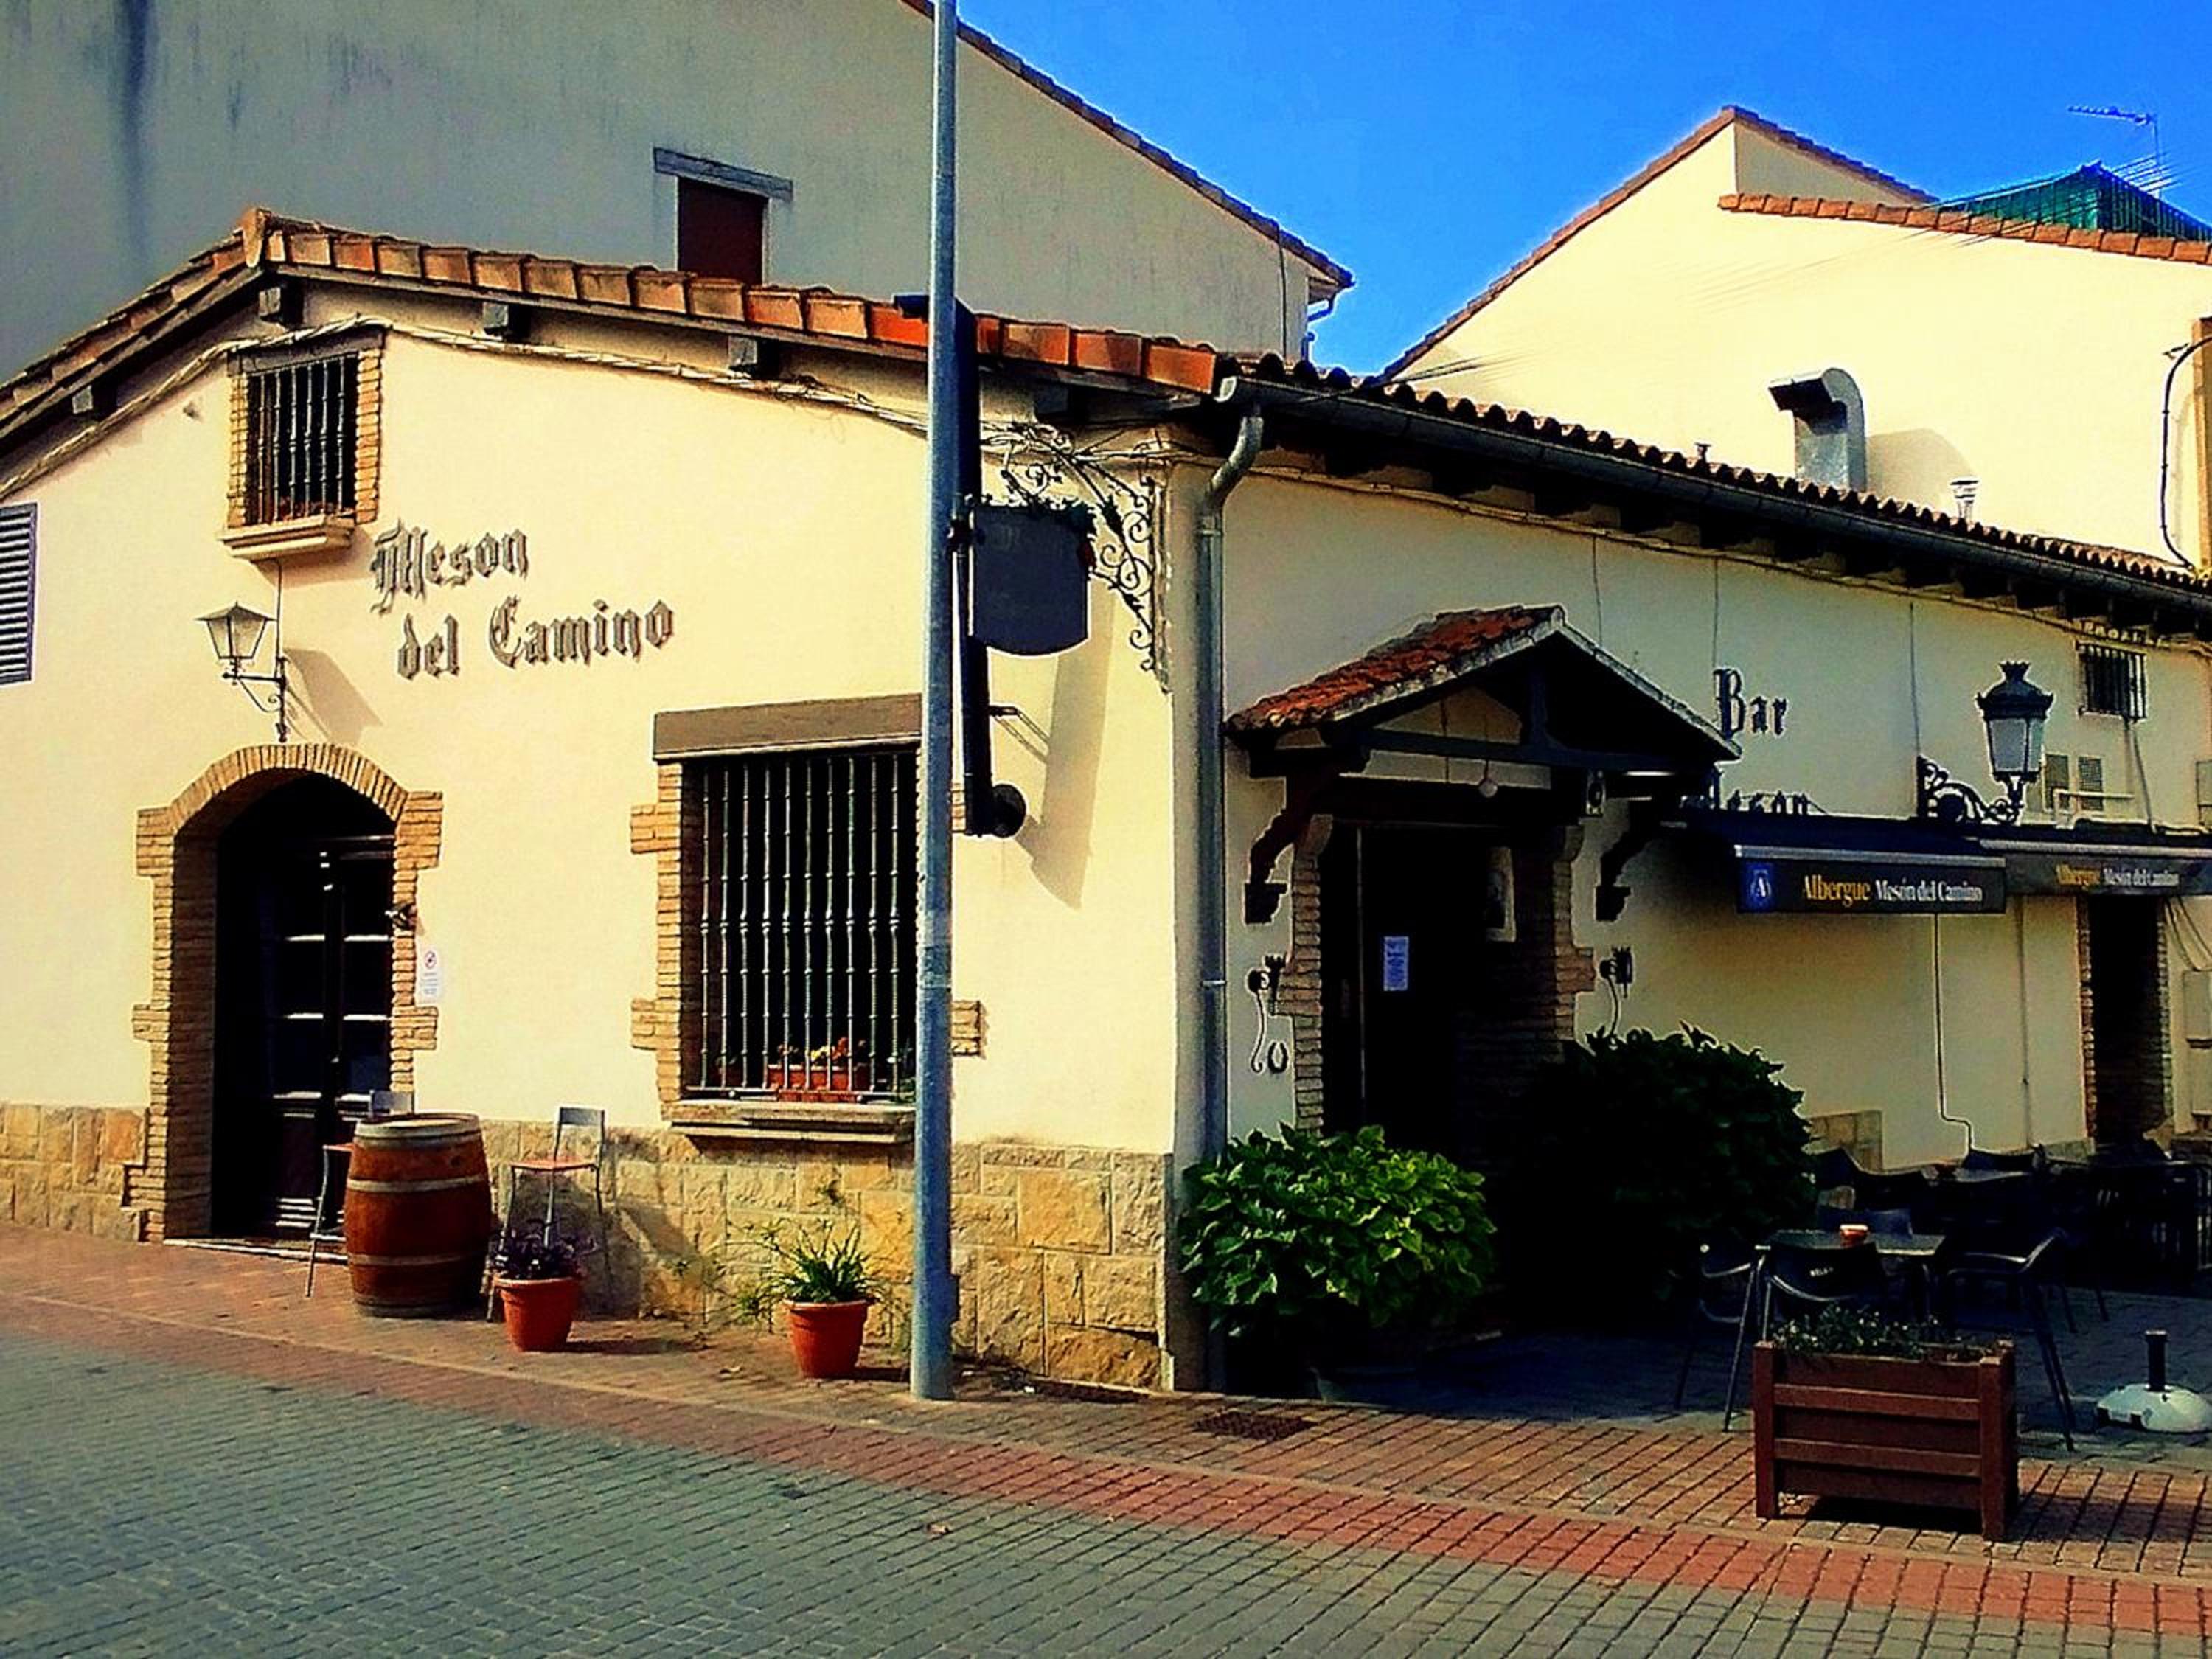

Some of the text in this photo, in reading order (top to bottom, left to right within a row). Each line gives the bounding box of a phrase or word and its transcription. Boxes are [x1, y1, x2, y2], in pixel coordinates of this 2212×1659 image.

[370, 518, 529, 614] Meson
[397, 596, 674, 680] del Camino
[1713, 668, 1787, 740] Bar
[1803, 874, 1871, 908] Albergue
[1917, 880, 1936, 901] del
[1938, 880, 1983, 902] Camino
